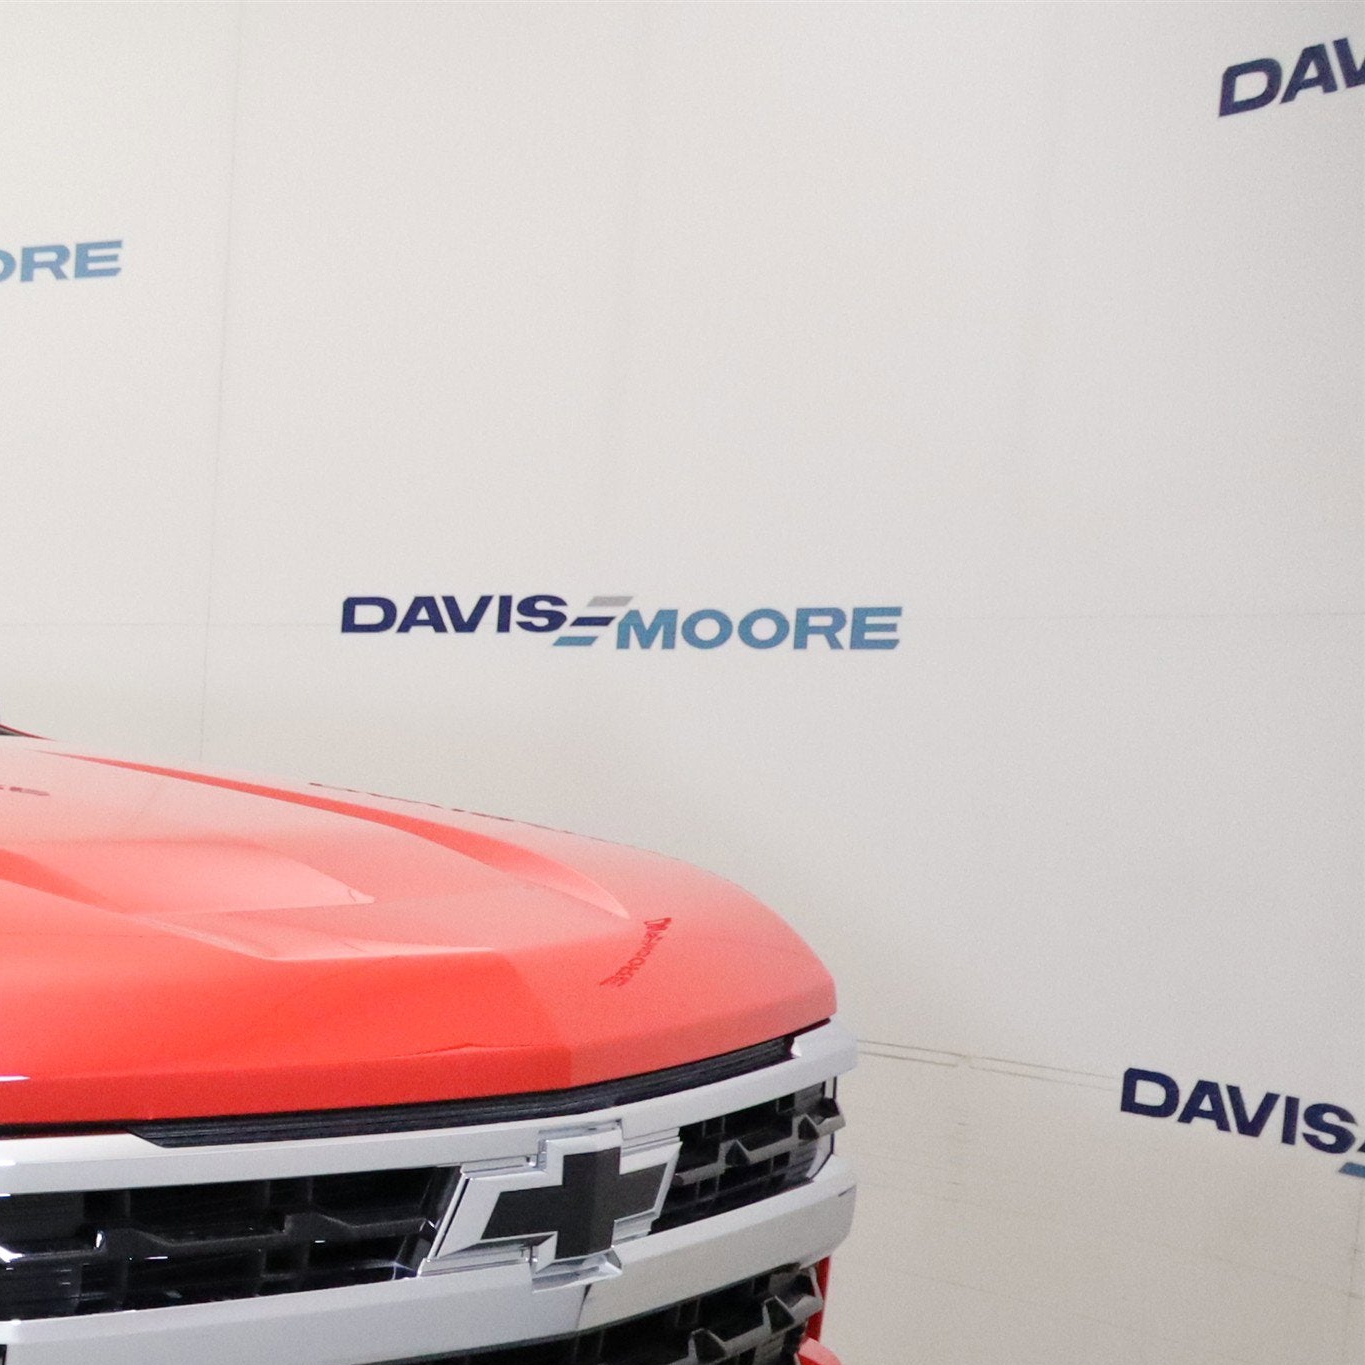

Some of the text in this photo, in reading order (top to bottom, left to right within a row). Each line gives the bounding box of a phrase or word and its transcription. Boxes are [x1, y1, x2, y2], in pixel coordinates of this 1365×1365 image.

[340, 594, 903, 650] DAVIS MOORE
[1120, 1067, 1358, 1155] DAVIS
